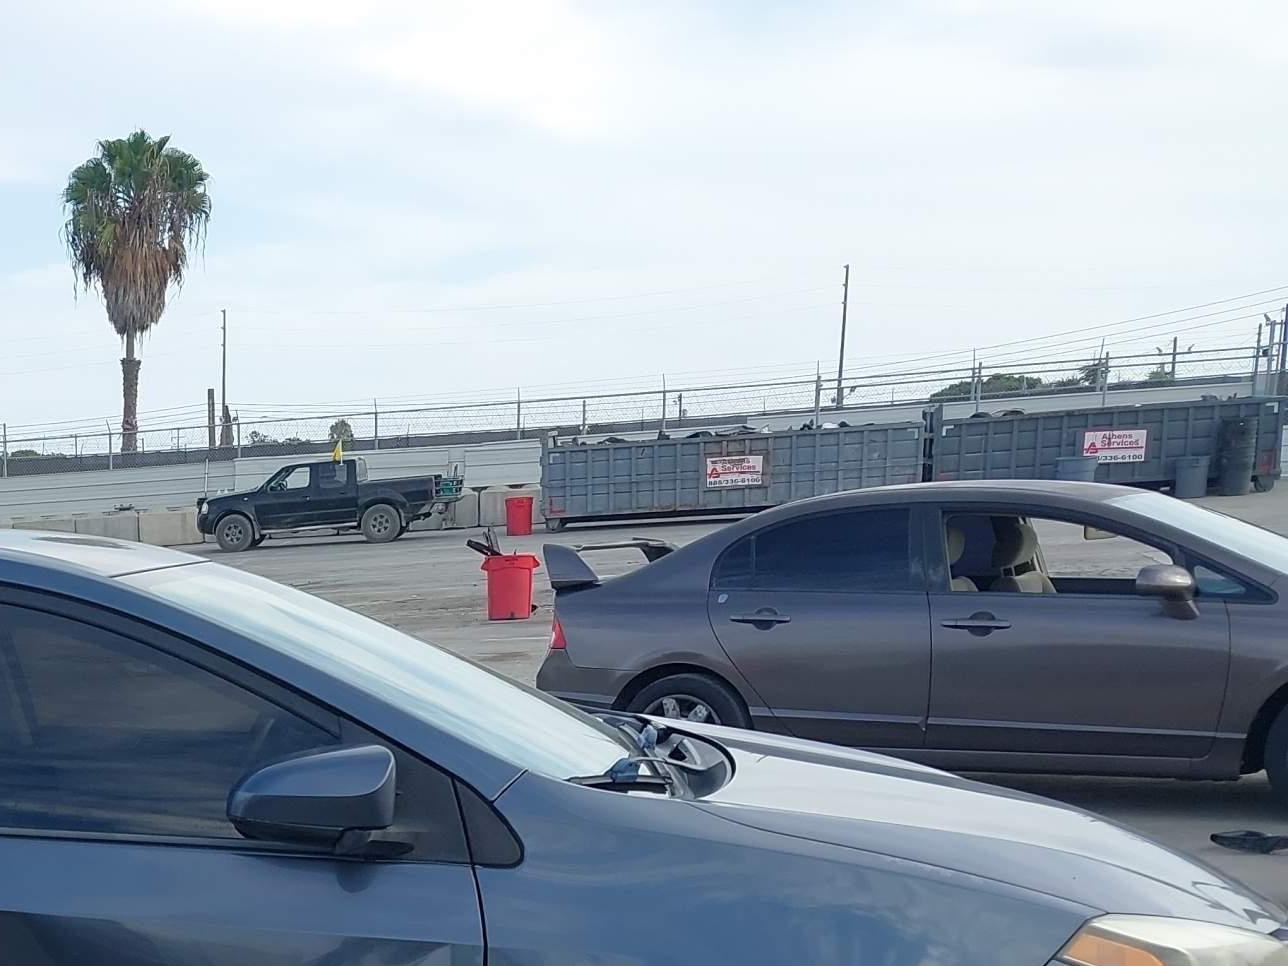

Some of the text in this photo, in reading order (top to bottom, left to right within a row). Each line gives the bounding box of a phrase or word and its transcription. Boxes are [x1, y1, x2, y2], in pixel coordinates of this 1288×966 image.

[1101, 431, 1133, 440] Athens
[1100, 439, 1140, 447] Services
[721, 464, 757, 472] Services
